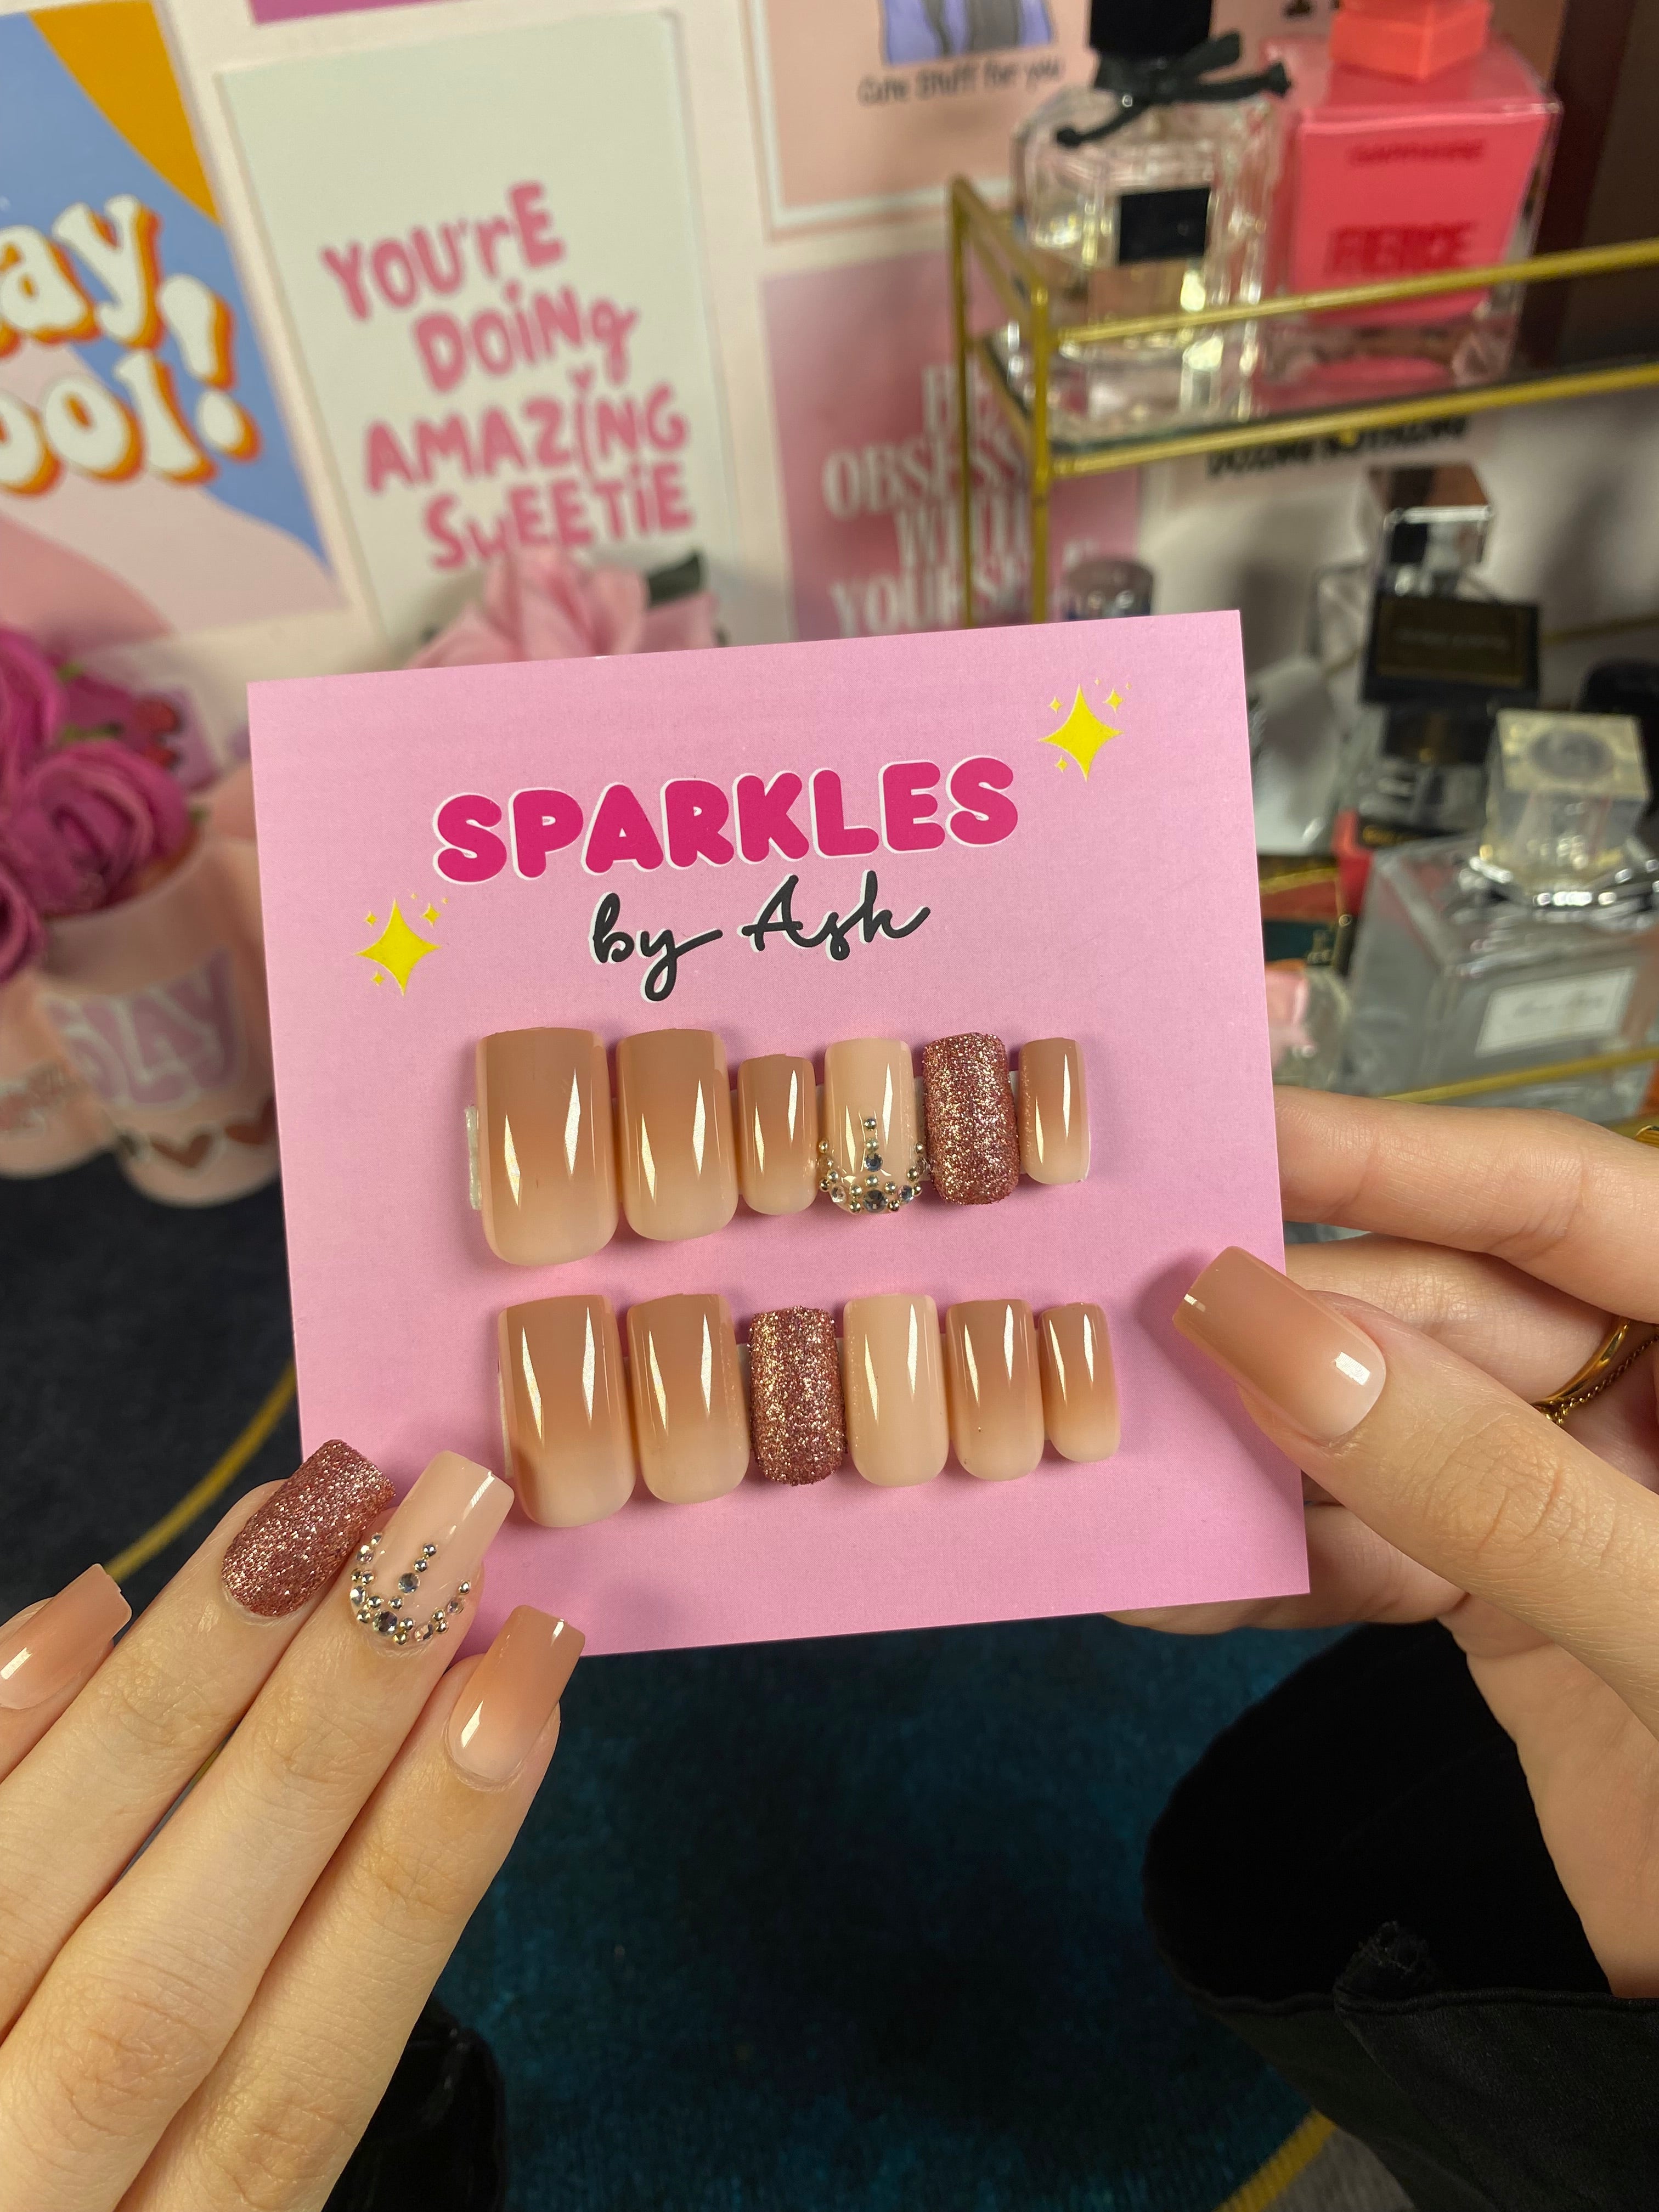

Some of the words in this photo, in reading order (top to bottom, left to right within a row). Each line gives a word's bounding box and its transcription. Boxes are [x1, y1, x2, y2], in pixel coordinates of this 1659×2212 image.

[437, 757, 1019, 883] SPARKLES
[591, 892, 724, 1002] by
[740, 870, 932, 961] Ash
